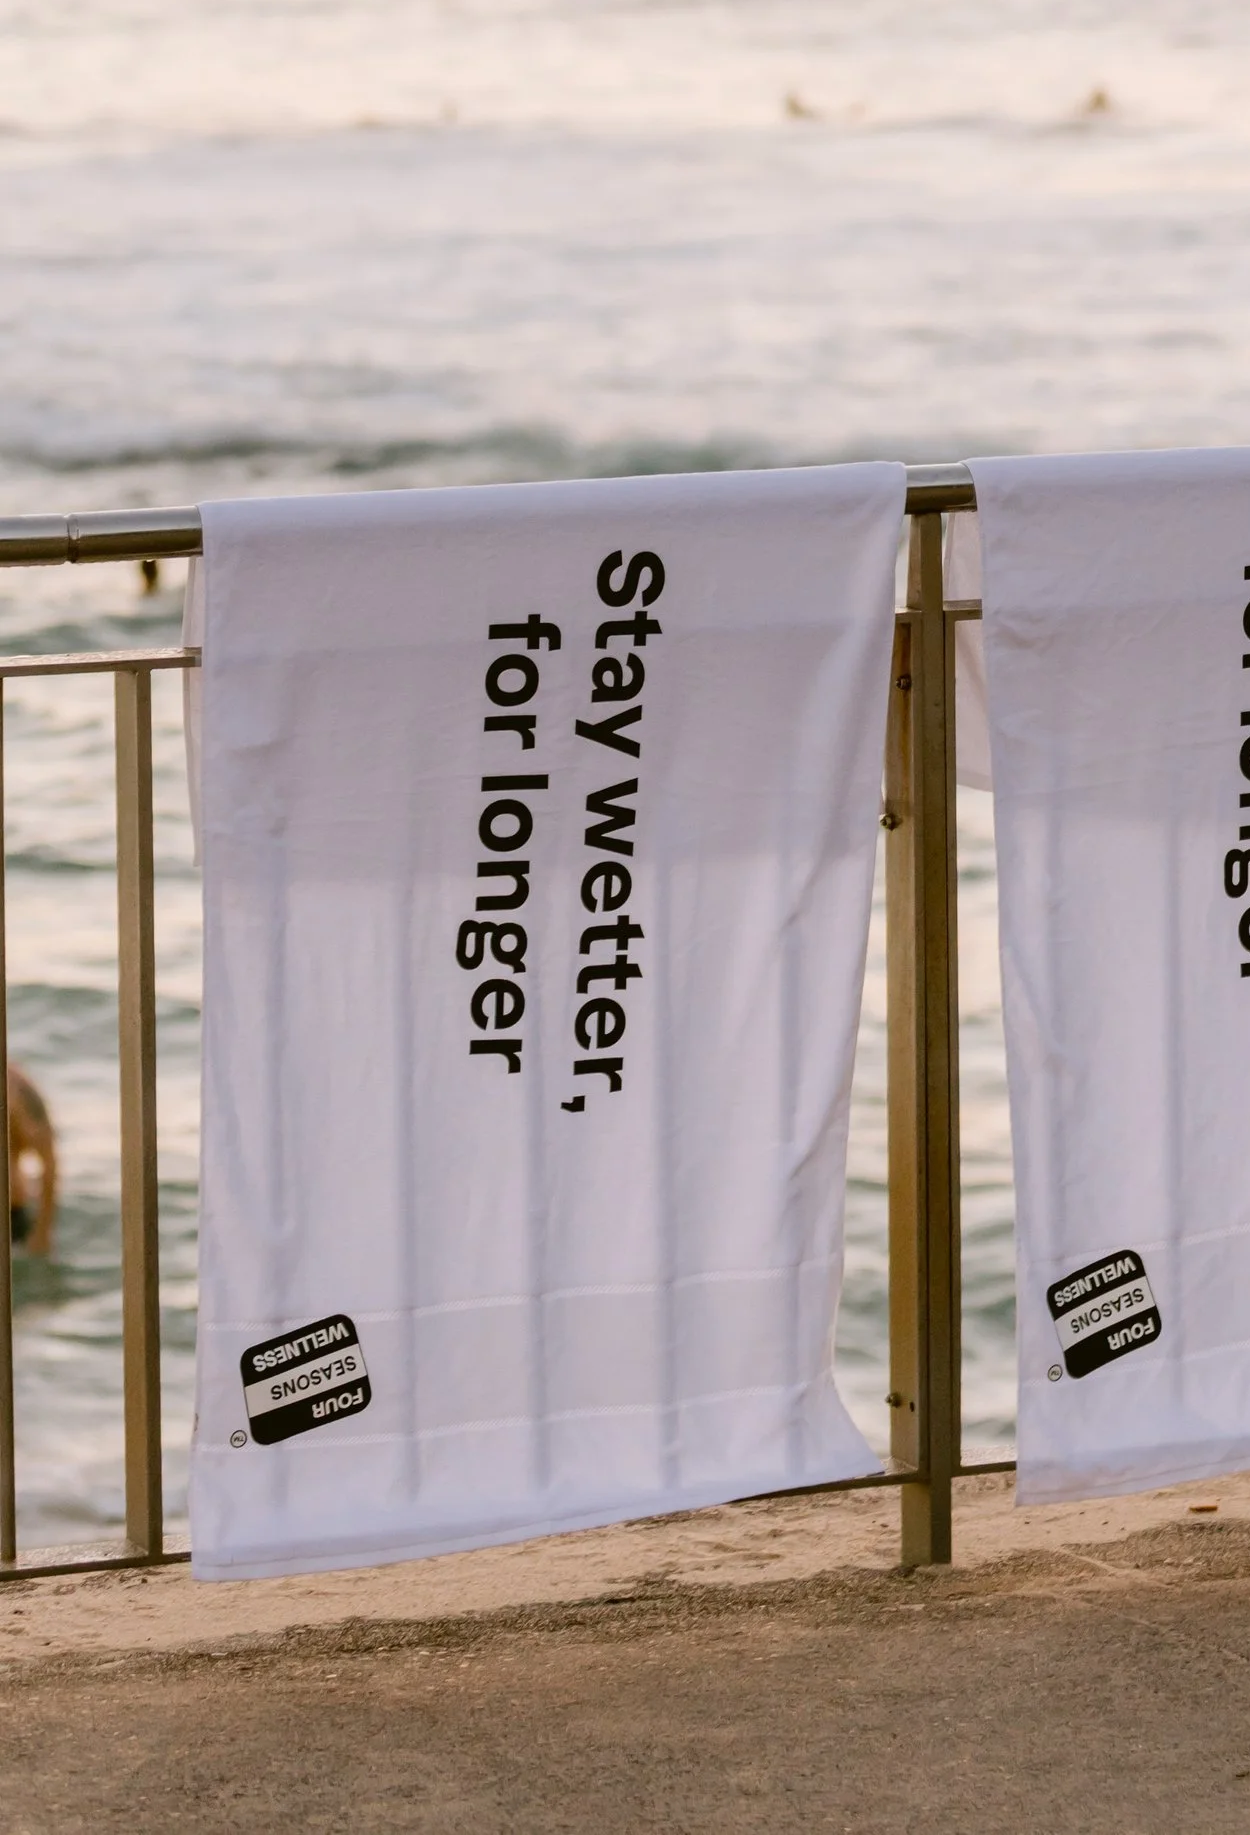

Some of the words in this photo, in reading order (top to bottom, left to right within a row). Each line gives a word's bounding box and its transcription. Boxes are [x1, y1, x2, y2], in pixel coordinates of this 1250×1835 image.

[574, 549, 666, 759] Stay
[483, 613, 562, 751] for
[455, 773, 550, 1074] longer
[560, 777, 645, 1113] wetter,
[1054, 1256, 1137, 1307] WELLNESS
[1070, 1288, 1145, 1334] SEASONS
[1106, 1317, 1156, 1351] FOUR
[252, 1322, 350, 1372] WELLNESS
[270, 1355, 357, 1400] SEASONS
[311, 1387, 364, 1419] FOUR
